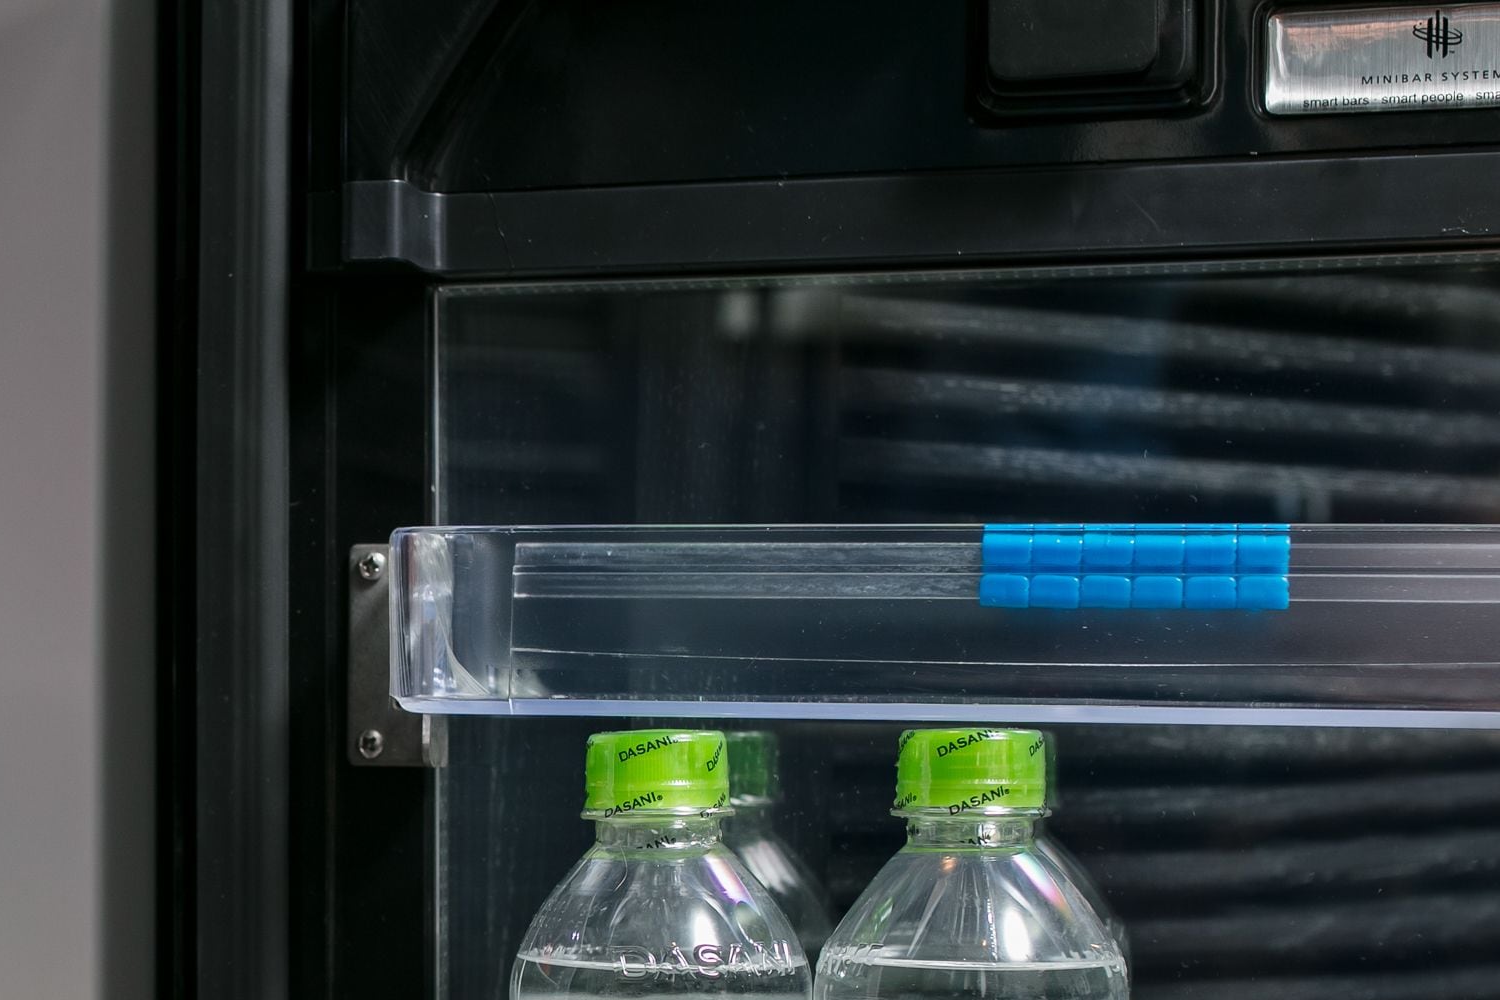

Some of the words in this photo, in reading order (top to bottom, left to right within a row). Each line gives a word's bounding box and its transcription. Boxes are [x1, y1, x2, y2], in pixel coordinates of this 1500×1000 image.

[1361, 73, 1432, 85] MINIBAR
[1303, 97, 1338, 108] smart
[1343, 96, 1370, 106] bars
[1381, 93, 1417, 105] smart
[1421, 90, 1464, 105] people
